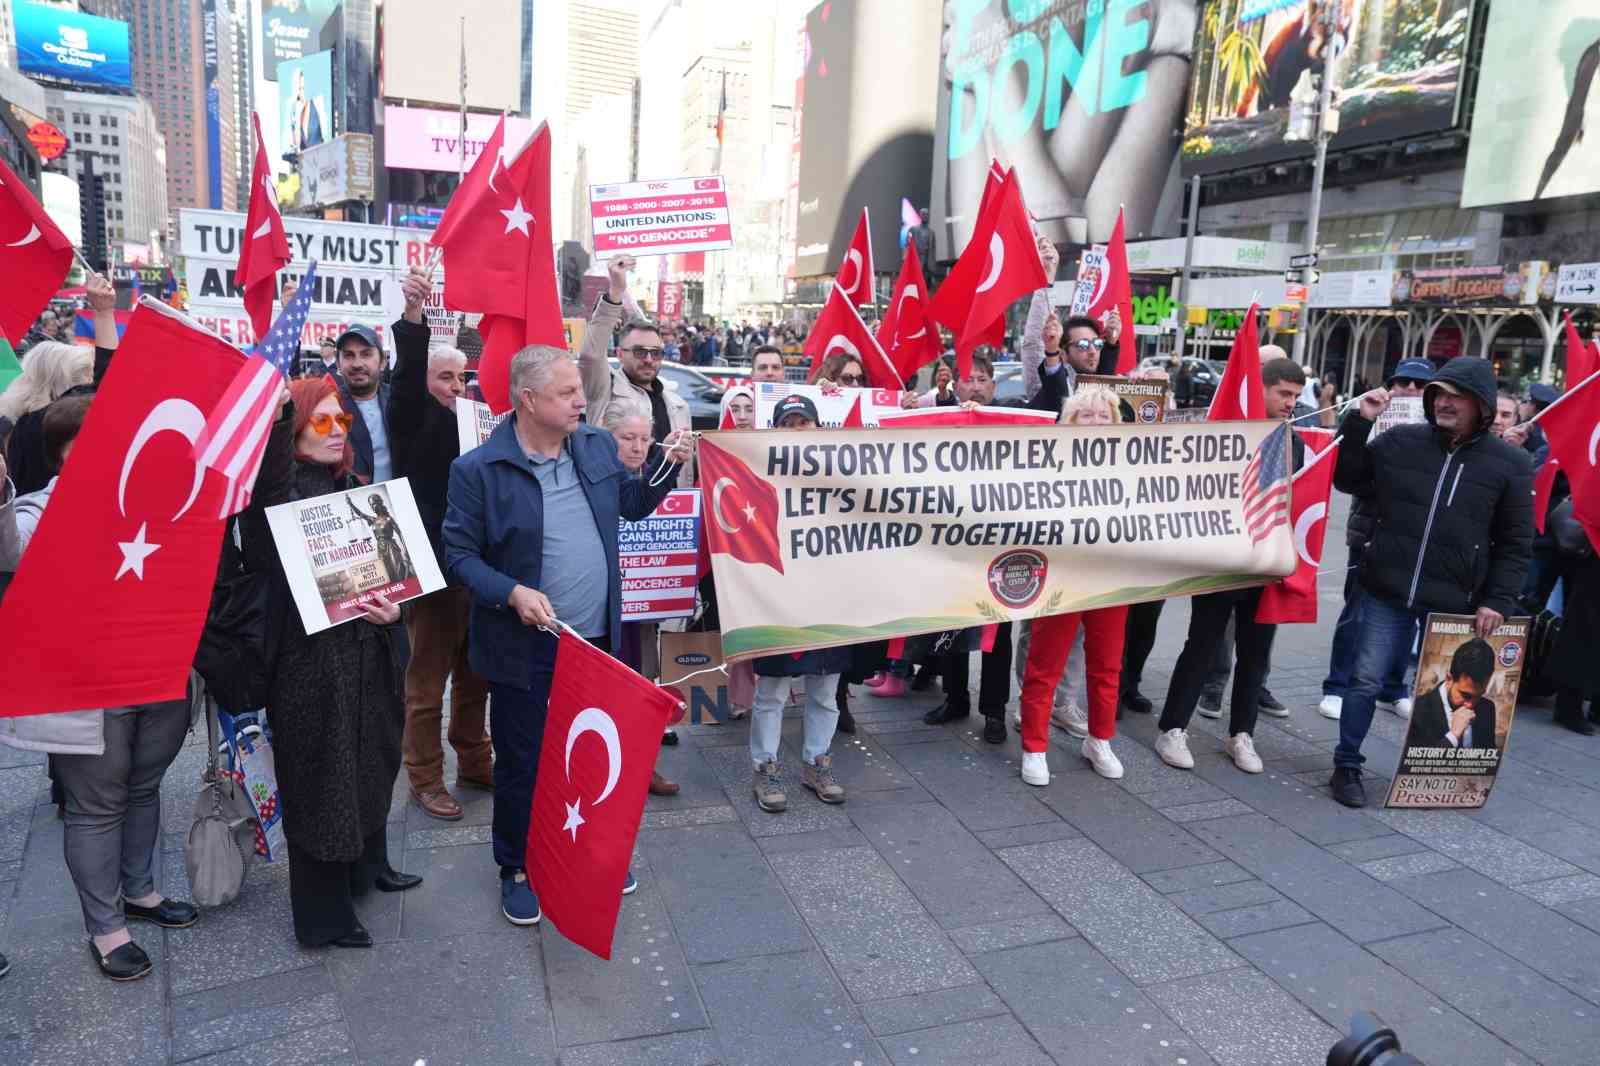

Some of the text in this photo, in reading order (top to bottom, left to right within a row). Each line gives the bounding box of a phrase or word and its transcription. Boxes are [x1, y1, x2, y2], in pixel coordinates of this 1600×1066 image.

[949, 0, 1153, 160] DONE
[606, 212, 717, 229] UNITED NATIONS:
[194, 224, 314, 257] TUEY
[322, 235, 400, 265] MUST
[200, 268, 383, 306] ARIAN
[431, 327, 456, 336] TITION.
[767, 433, 1253, 476] HISTORY IS COMPLEX, NOT ONE-SIDED.
[785, 473, 1240, 518] LET’S LISTEN, UNDERSTAND, AND MOVE
[300, 504, 333, 523] JUSTICE
[303, 517, 344, 537] REQUIRES
[649, 519, 694, 531] RIGHTS
[619, 530, 694, 543] CANS, HURLS
[791, 509, 1241, 559] FORWARD TOGETHER TO OUR FUTURE.
[313, 540, 376, 568] NOT NARRATIVES.
[633, 543, 646, 551] OF
[641, 556, 667, 566] LAW
[622, 578, 681, 590] NOCENCE
[622, 602, 649, 612] VERS
[1432, 622, 1470, 634] MAMDANI
[1492, 625, 1526, 637] ECTFULLY,
[1407, 747, 1446, 759] HISTORY
[1446, 748, 1455, 759] IS
[1400, 777, 1457, 790] SAY NO TO
